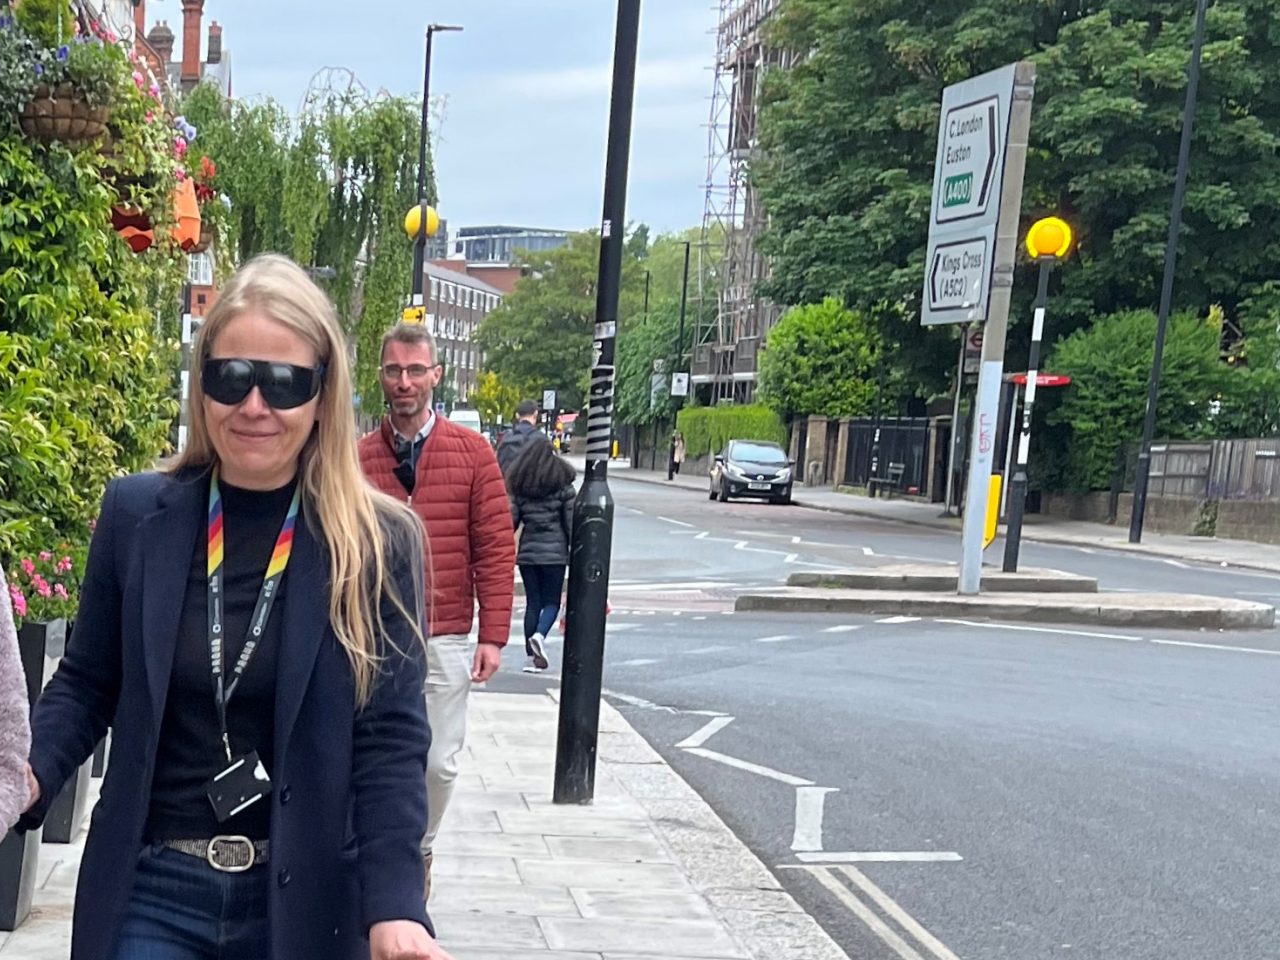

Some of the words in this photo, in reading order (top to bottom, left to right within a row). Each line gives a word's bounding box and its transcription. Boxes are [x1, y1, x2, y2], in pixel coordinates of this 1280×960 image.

[946, 145, 971, 165] Euston
[944, 175, 972, 205] (A400)
[942, 253, 961, 275] Kings
[962, 250, 982, 270] Cross
